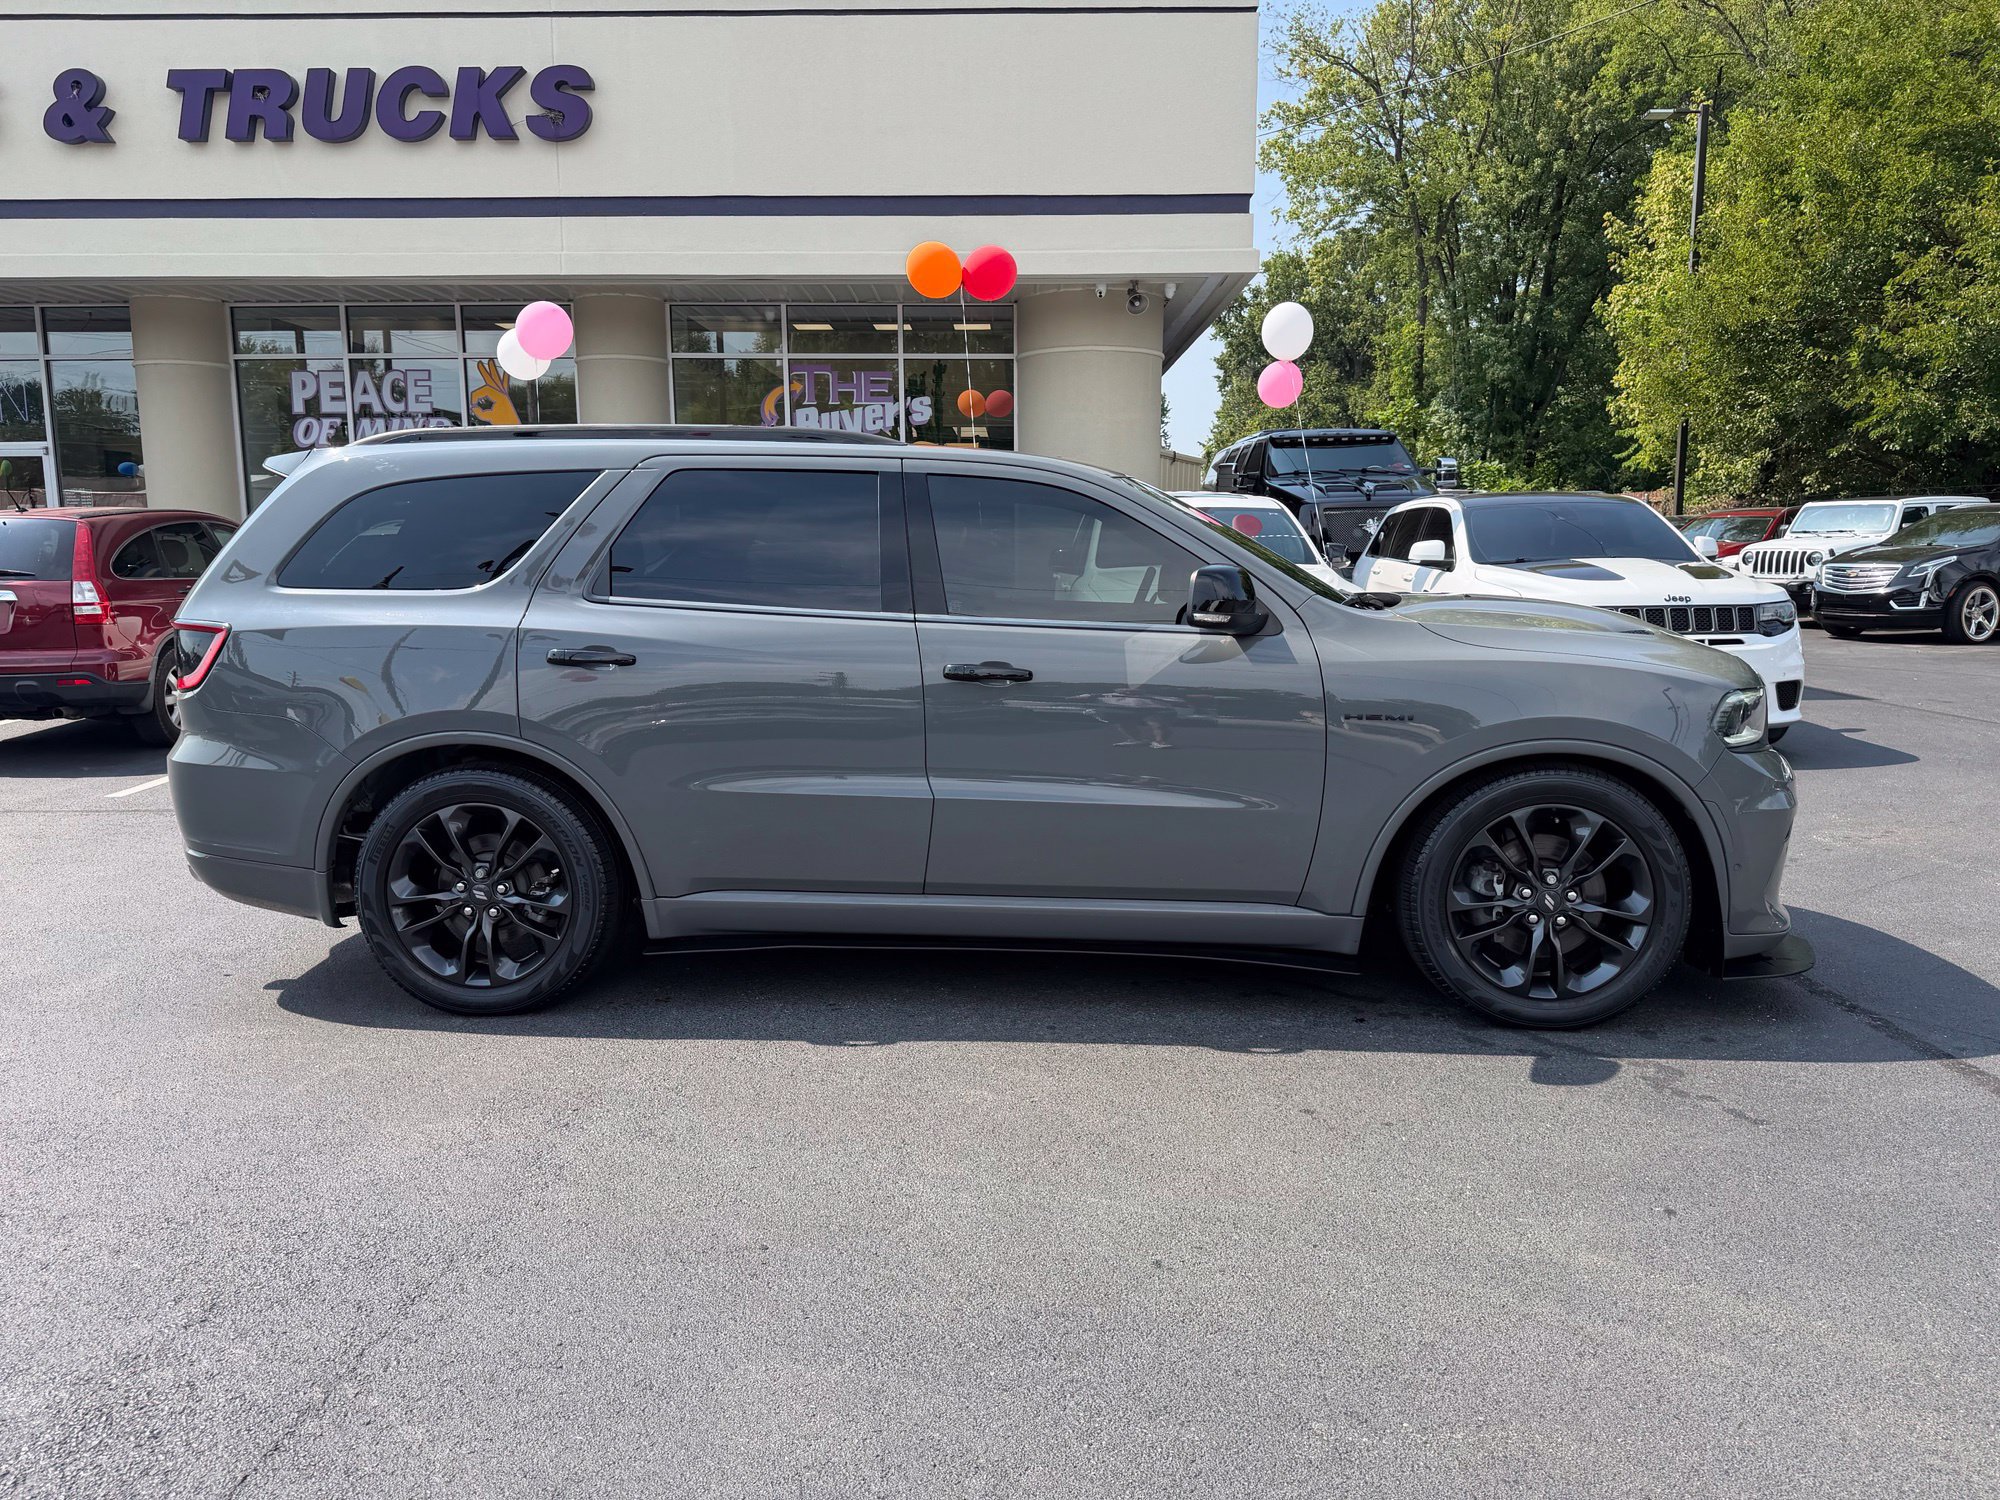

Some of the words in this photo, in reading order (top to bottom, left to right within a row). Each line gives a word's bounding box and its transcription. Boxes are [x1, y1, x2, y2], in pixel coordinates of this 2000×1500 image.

[43, 67, 116, 145] &
[166, 64, 596, 144] TRUCKS
[290, 369, 434, 415] PEACE
[790, 364, 893, 404] THE
[293, 417, 342, 448] OF
[1664, 594, 1692, 603] Jeep
[1343, 713, 1415, 722] HEMI
